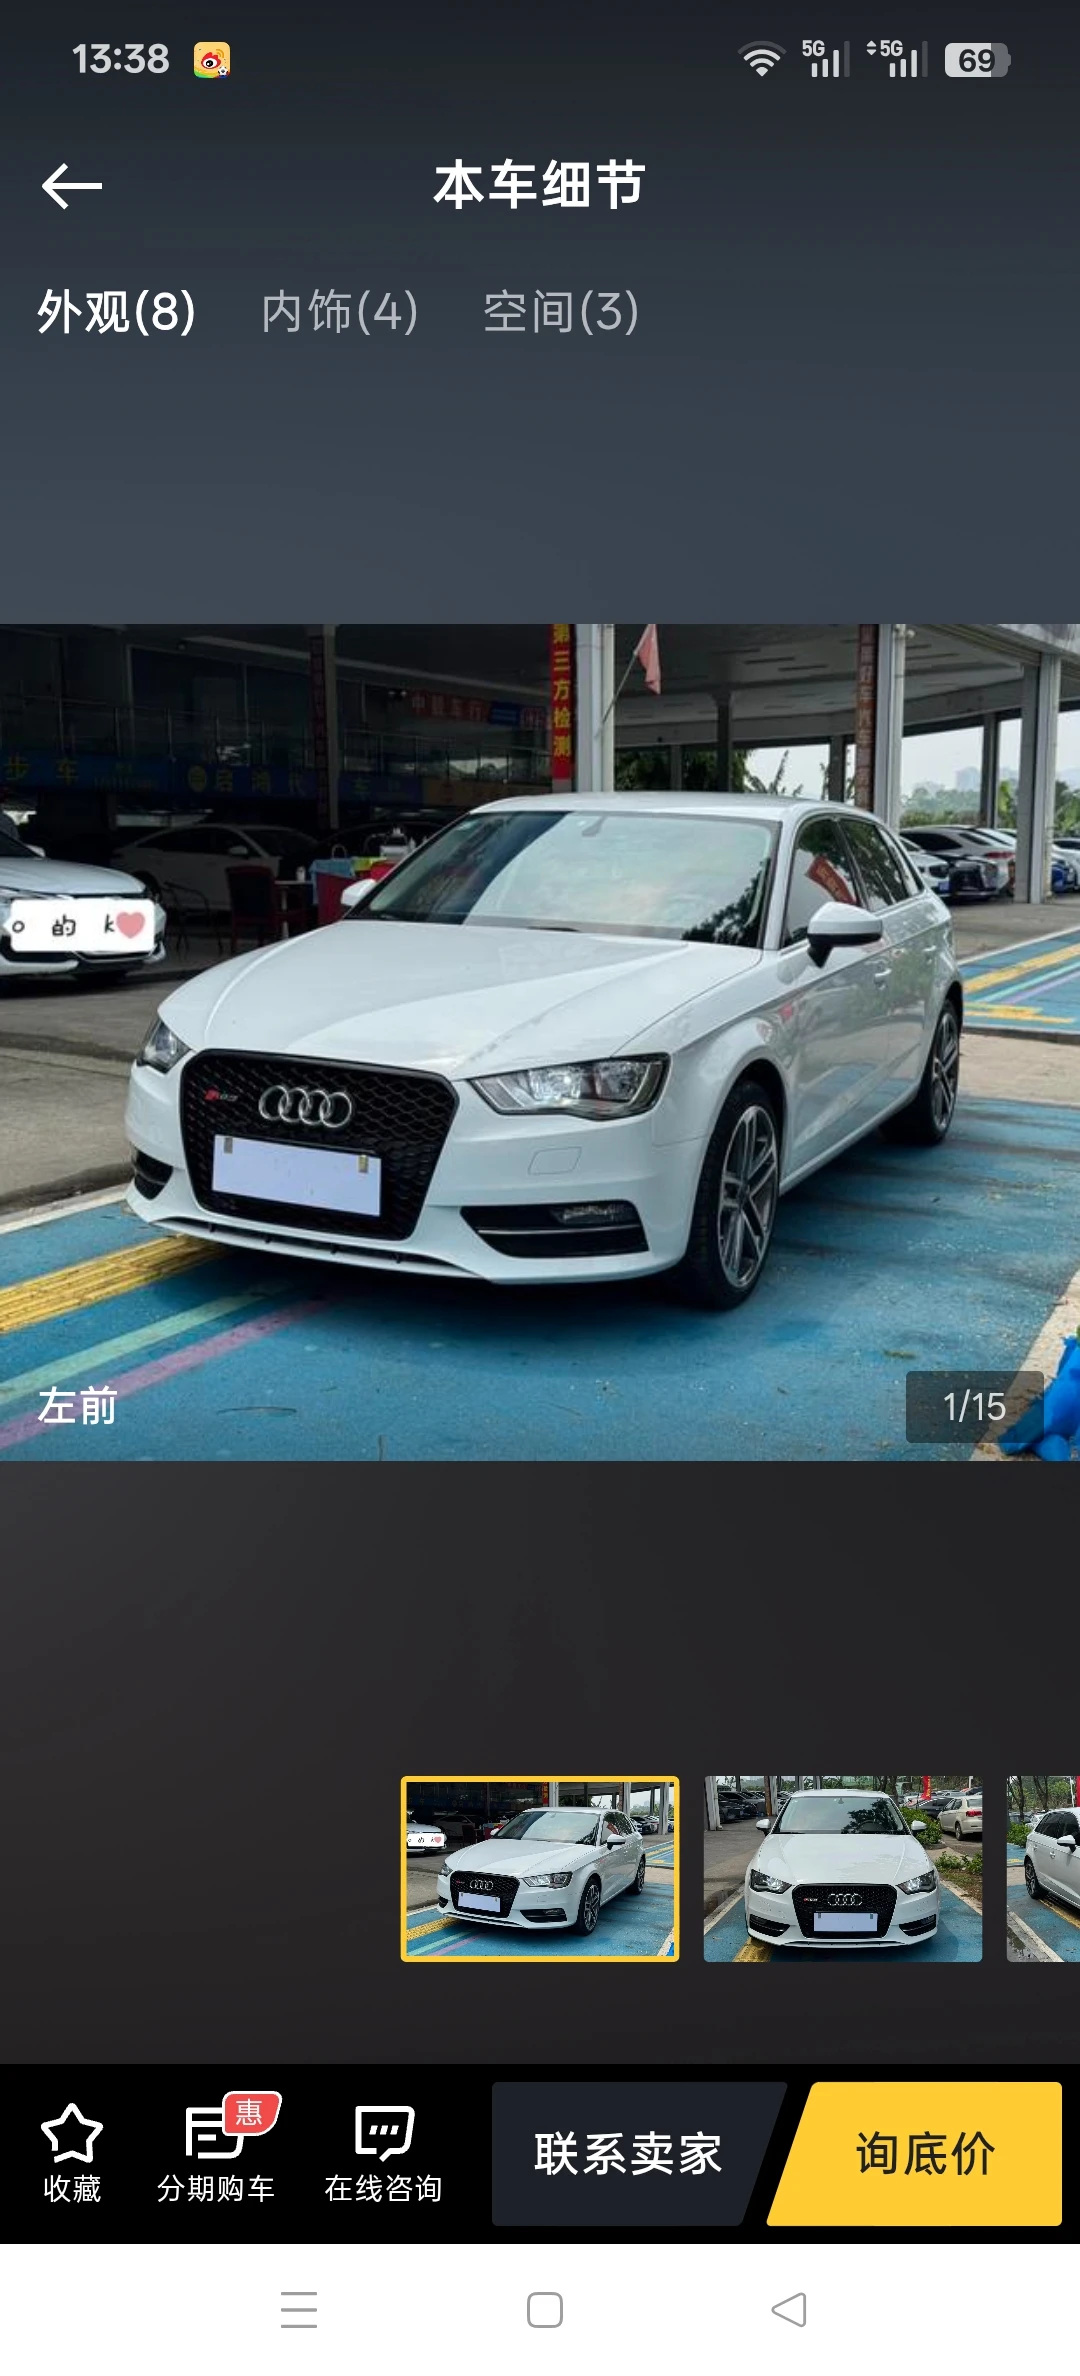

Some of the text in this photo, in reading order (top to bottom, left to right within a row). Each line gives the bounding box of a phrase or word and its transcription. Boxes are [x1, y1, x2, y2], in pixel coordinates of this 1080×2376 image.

[73, 43, 170, 74] 13:38
[803, 40, 825, 57] 5G
[881, 40, 903, 57] 5G
[959, 49, 996, 73] 69
[433, 159, 646, 210] 本车细节
[37, 289, 195, 336] 外观(8)
[263, 289, 417, 336] 内饰(4)
[484, 289, 638, 336] 空间(3)
[552, 624, 572, 757] 第三方检测
[38, 1385, 118, 1425] 左前
[944, 1389, 1006, 1423] 1/15
[236, 2099, 263, 2126] 惠
[534, 2131, 723, 2176] 联系卖家
[857, 2131, 996, 2176] 询底价
[43, 2174, 101, 2203] 收藏
[157, 2173, 275, 2203] 分期购车
[325, 2173, 442, 2203] 在线咨询
